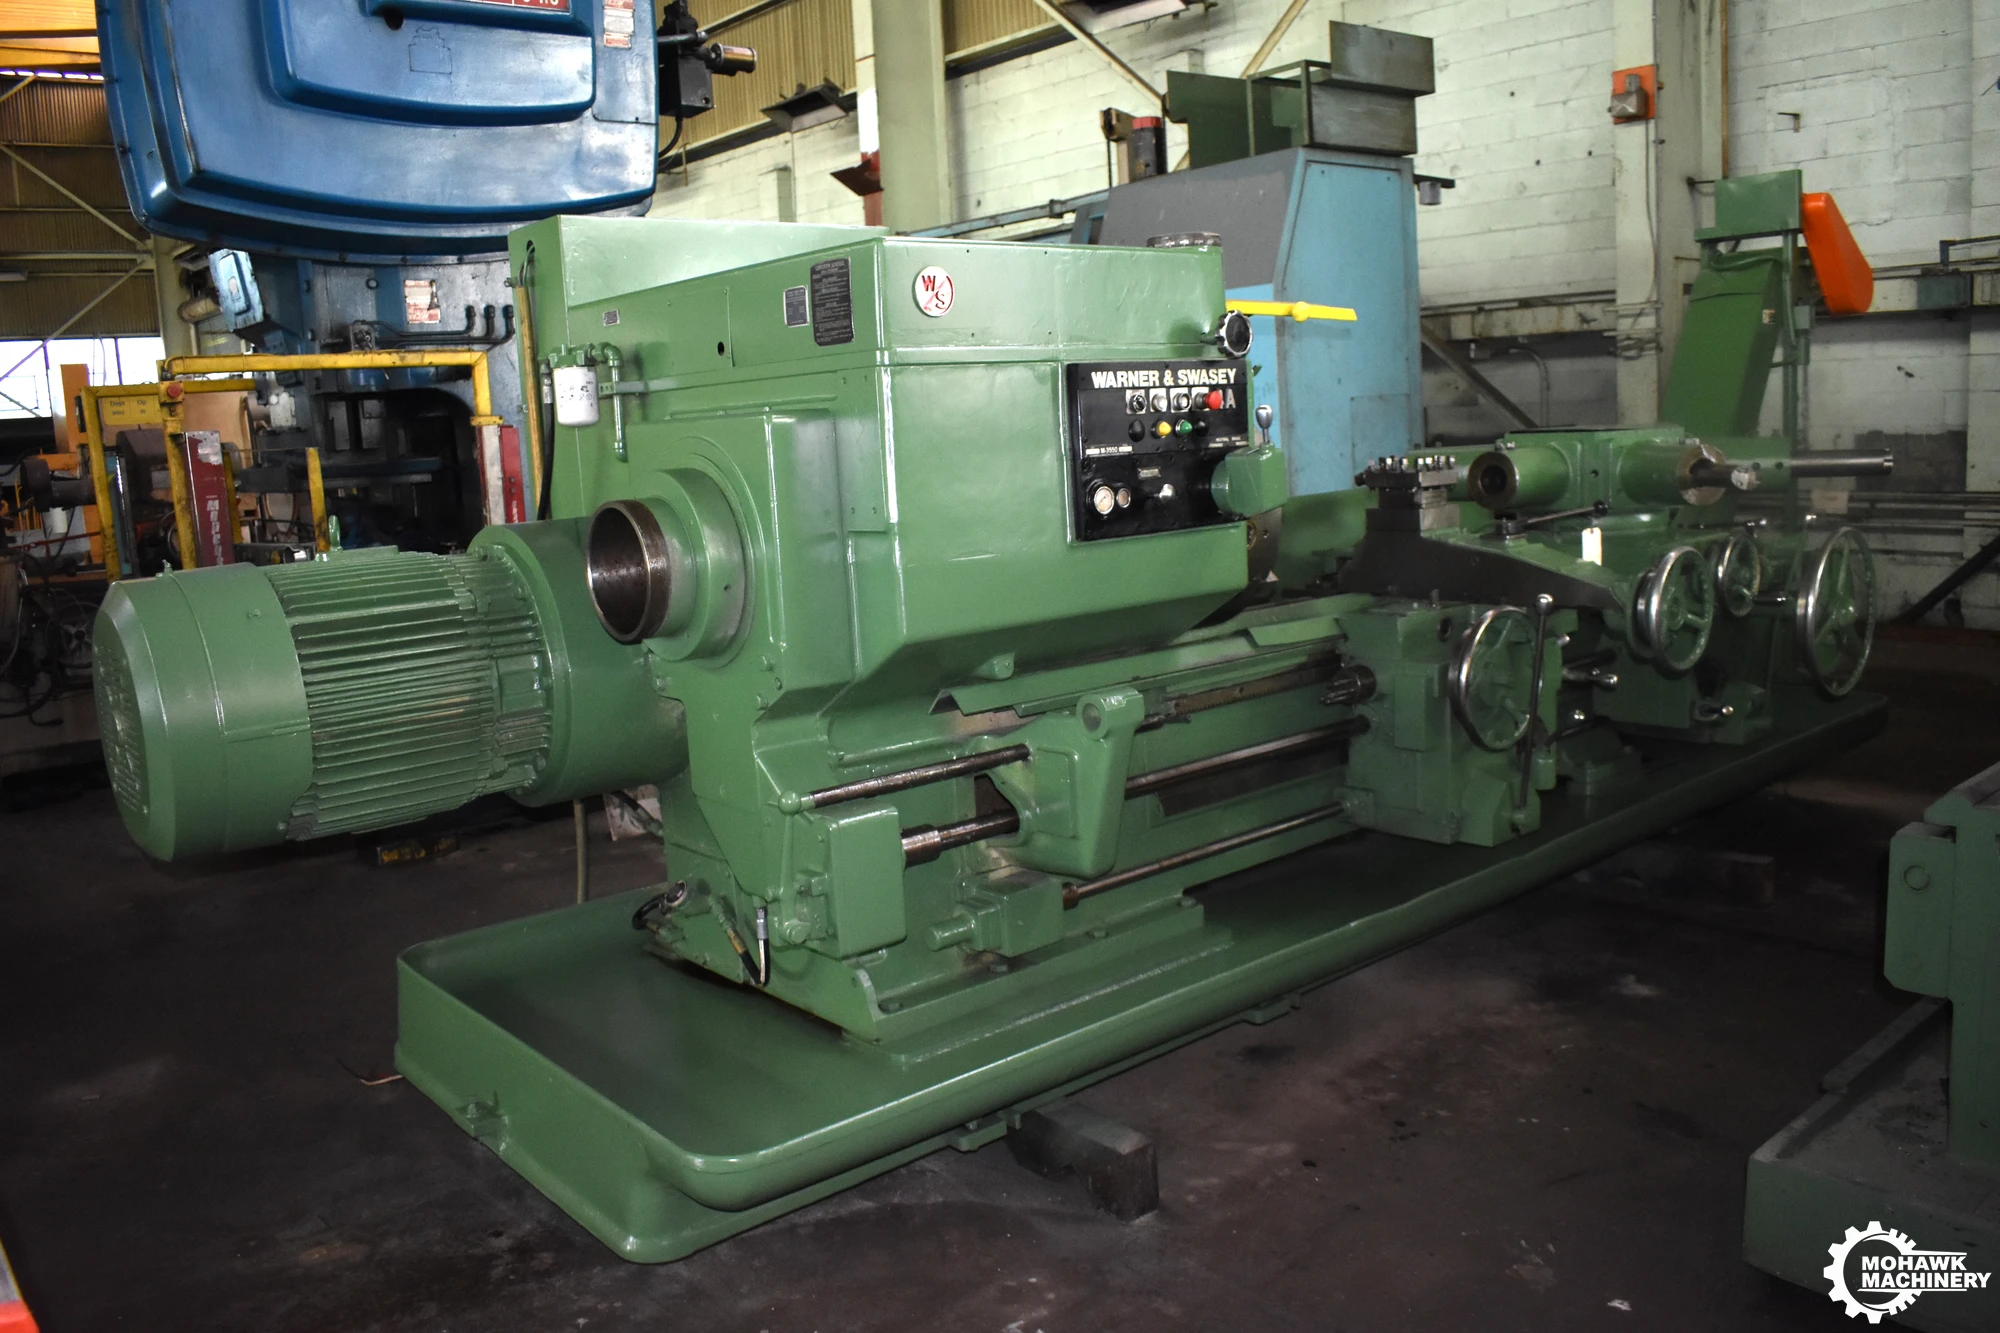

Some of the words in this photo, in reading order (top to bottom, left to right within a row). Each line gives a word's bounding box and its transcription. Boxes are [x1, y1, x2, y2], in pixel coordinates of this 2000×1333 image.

[921, 274, 936, 292] W
[1091, 370, 1160, 389] WARNER
[1163, 369, 1174, 386] &
[1177, 368, 1237, 386] SWASEY
